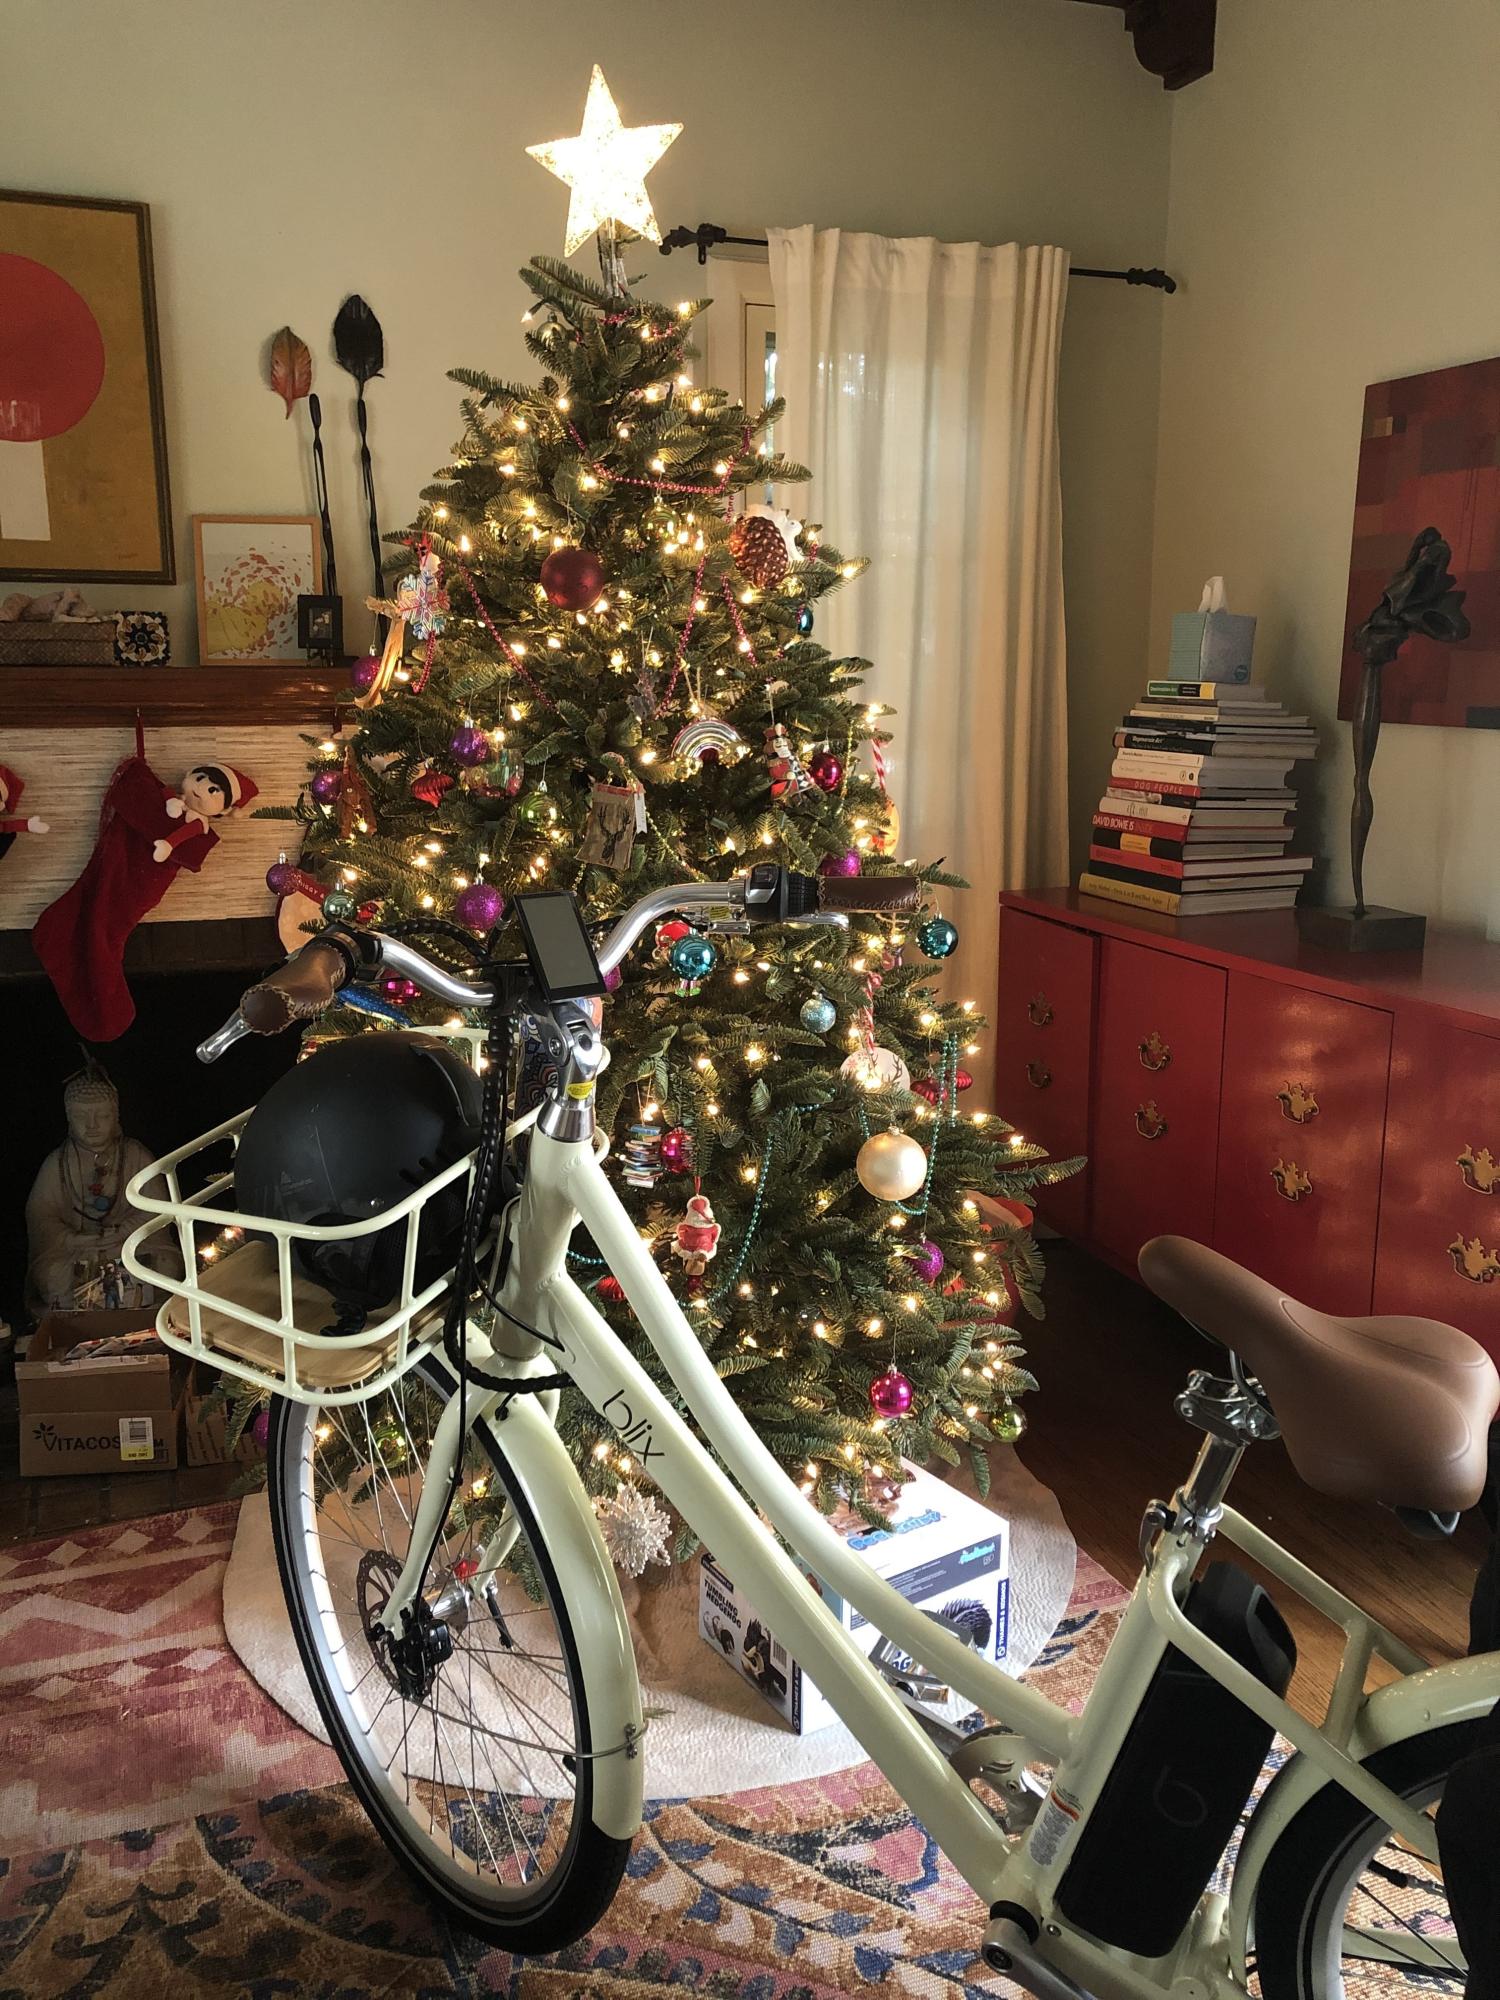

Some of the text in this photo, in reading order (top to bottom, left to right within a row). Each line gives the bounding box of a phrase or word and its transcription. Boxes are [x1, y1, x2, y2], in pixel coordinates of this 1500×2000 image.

[1134, 781, 1151, 790] DOG
[1154, 783, 1184, 794] PEOPLE
[1092, 815, 1110, 827] DAVID
[1110, 818, 1128, 830] BOWIE
[602, 1389, 665, 1468] blix
[704, 1579, 738, 1616] TUMBLING
[706, 1591, 741, 1629] HEDGEHOG
